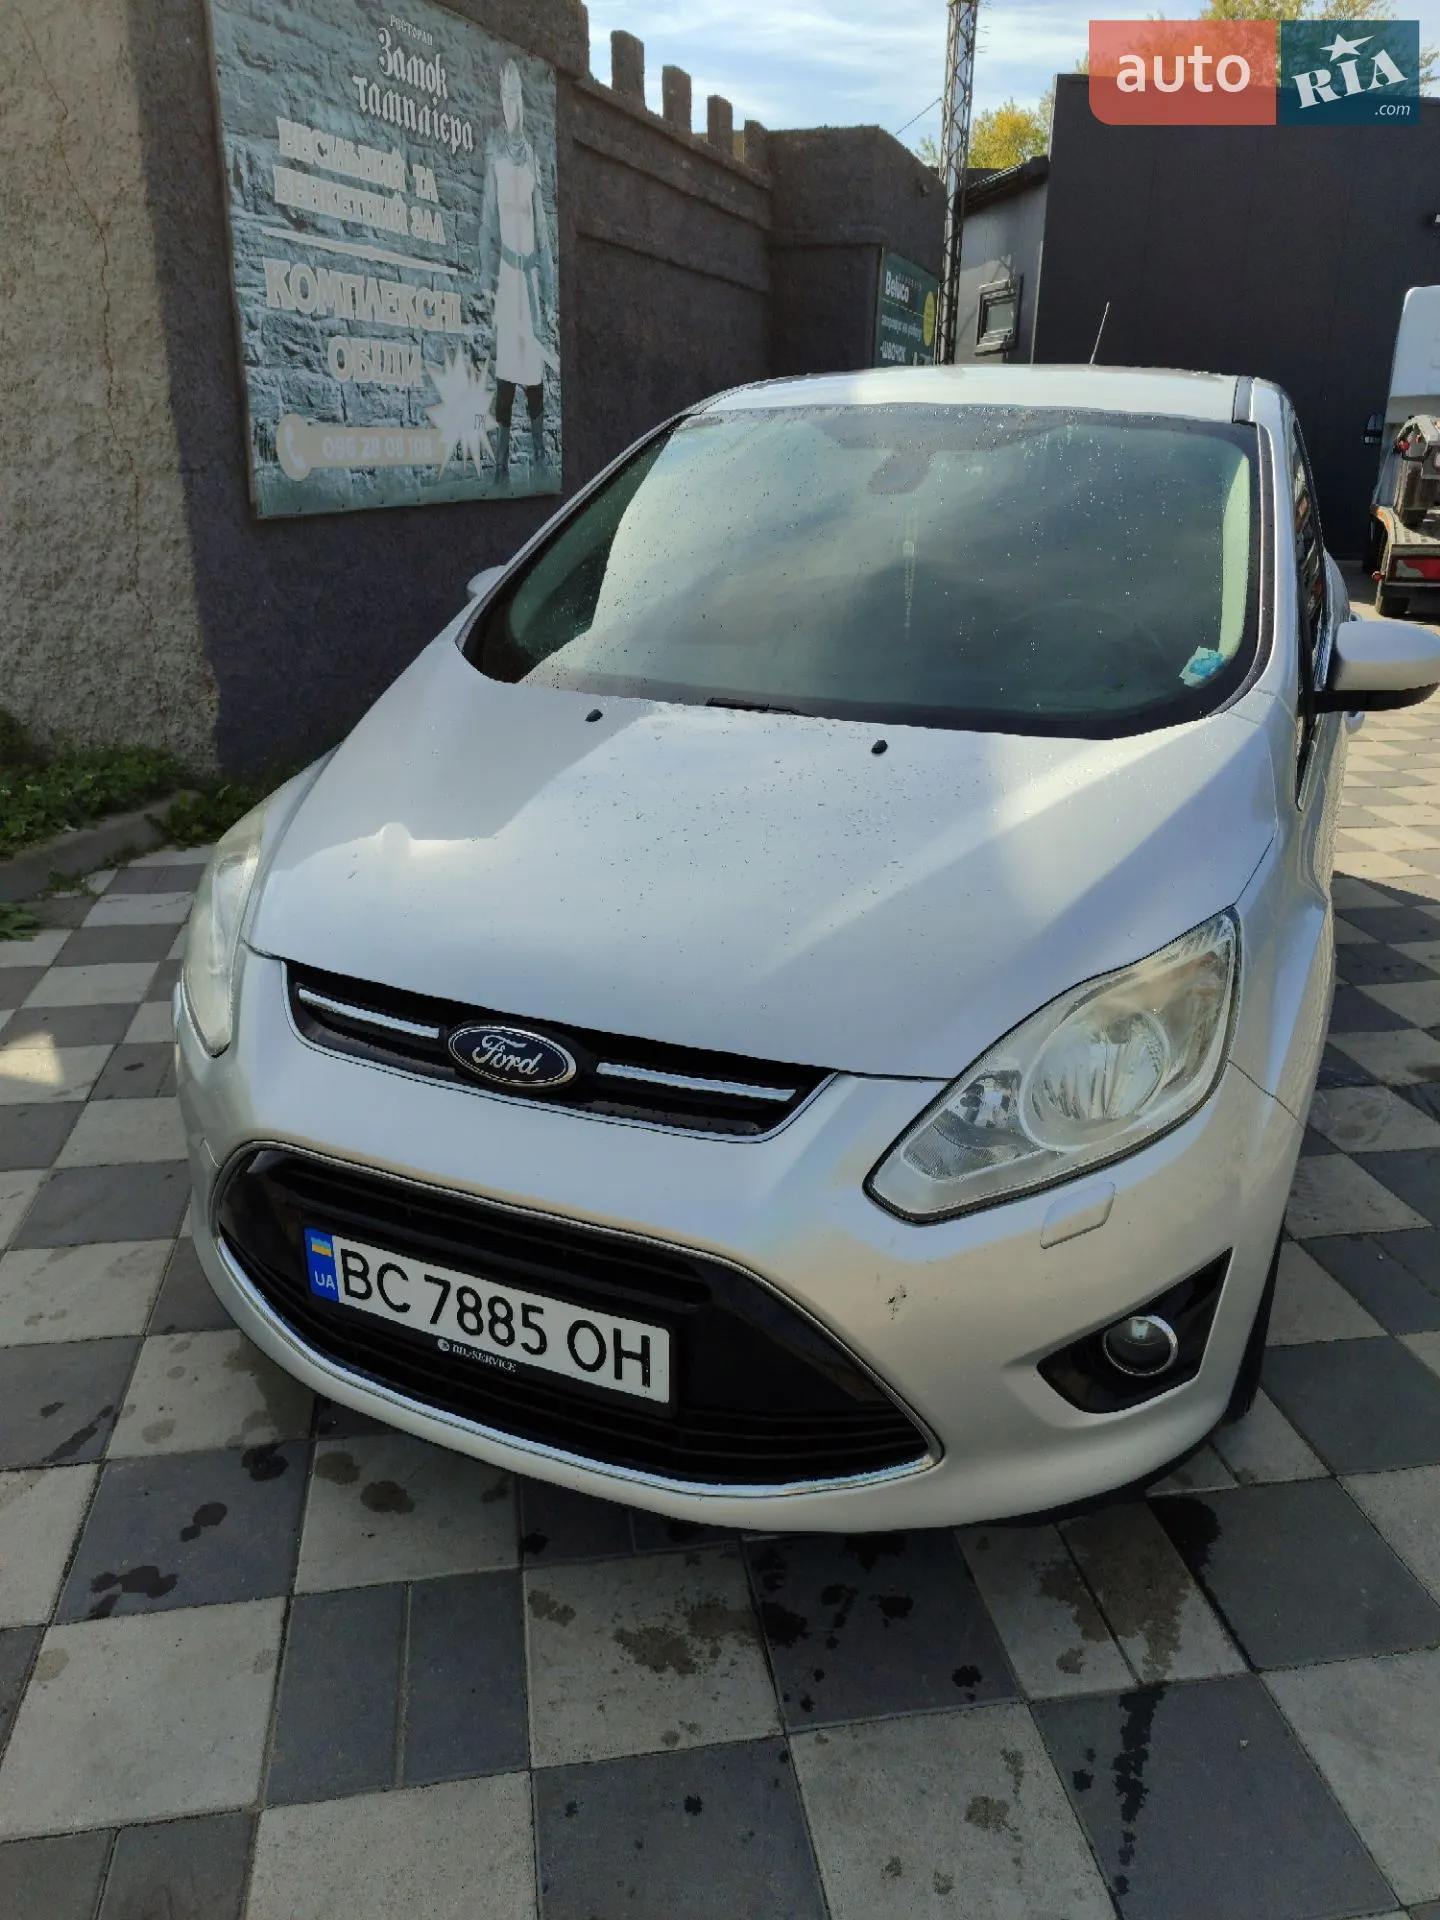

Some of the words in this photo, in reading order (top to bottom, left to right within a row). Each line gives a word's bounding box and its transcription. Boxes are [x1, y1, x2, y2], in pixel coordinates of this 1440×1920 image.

[377, 27, 449, 100] Замок
[262, 258, 464, 334] КОМПЛЕКСНІ
[472, 1035, 543, 1075] Ford
[314, 1271, 336, 1290] UA
[340, 1248, 411, 1313] BC
[424, 1274, 548, 1356] 7885
[566, 1319, 651, 1388] OH
